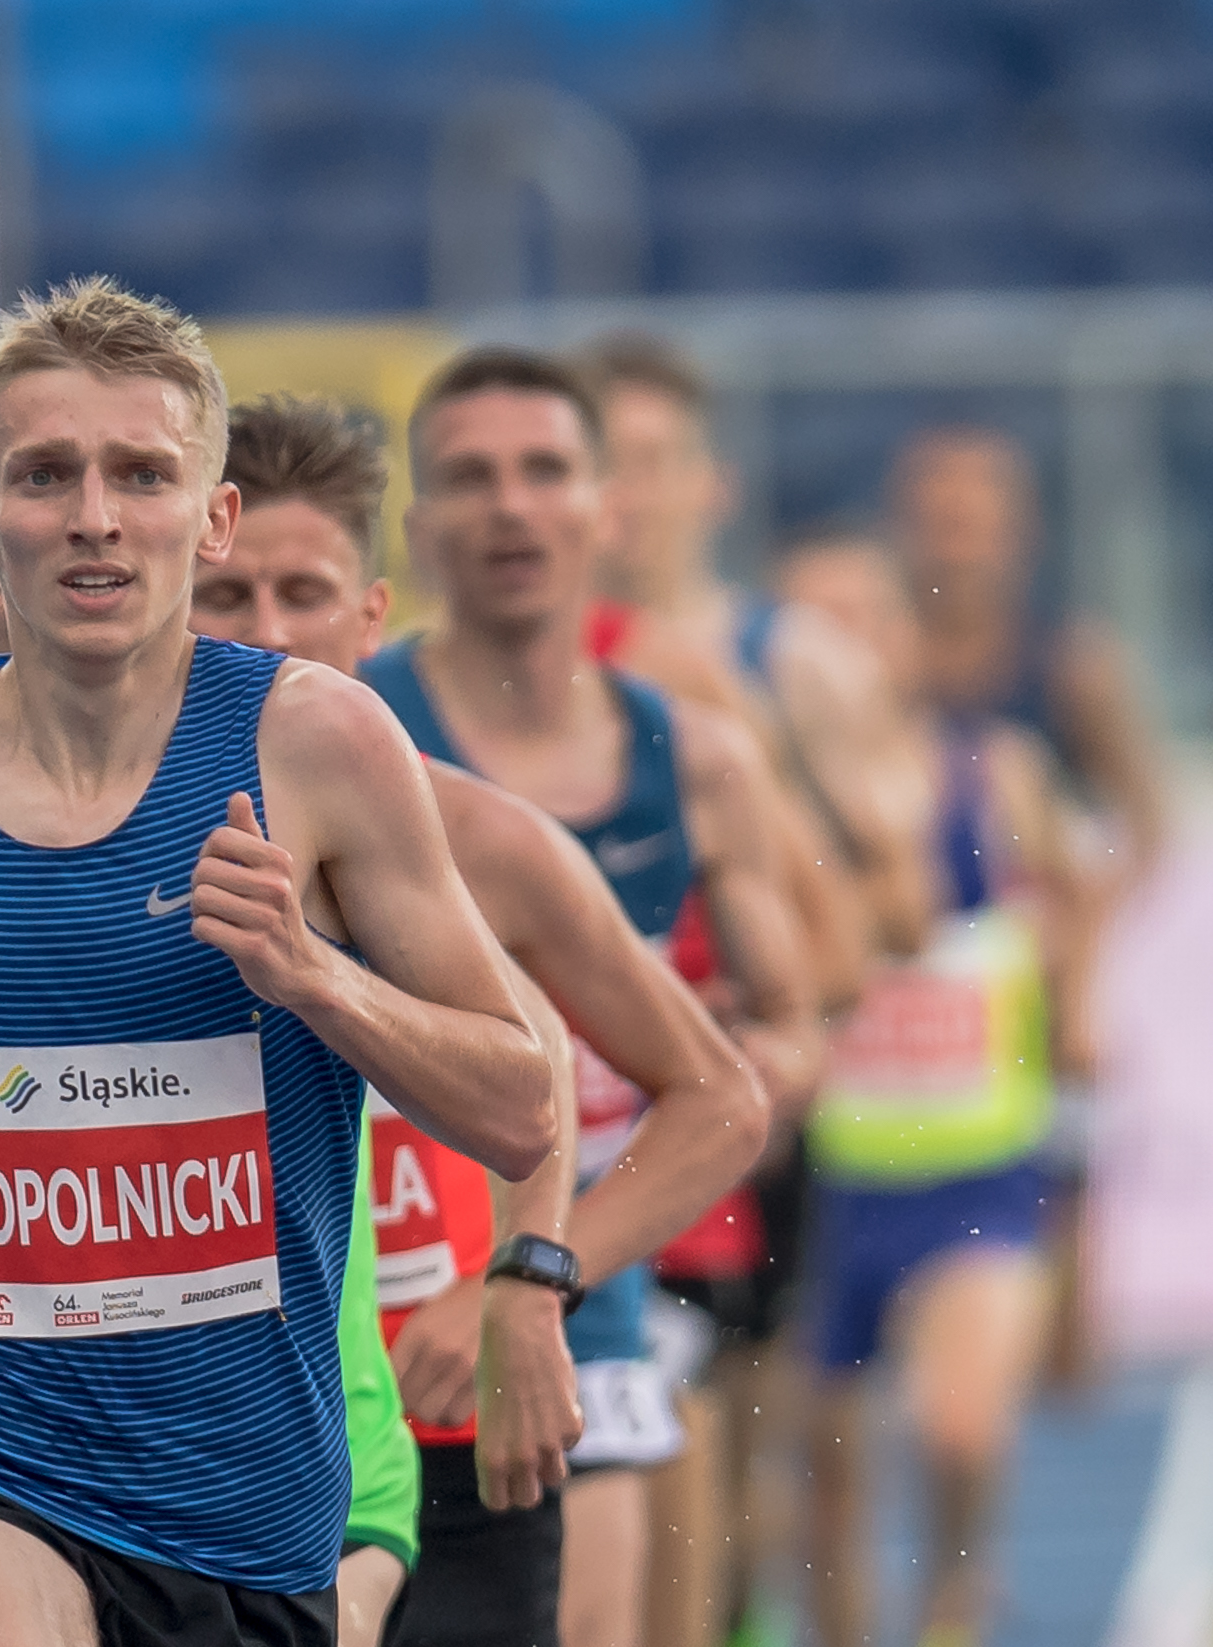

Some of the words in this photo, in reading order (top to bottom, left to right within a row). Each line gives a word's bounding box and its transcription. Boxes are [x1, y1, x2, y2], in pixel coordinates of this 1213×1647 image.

[59, 1065, 191, 1108] Śląskie.
[101, 1287, 143, 1300] Memorial
[181, 1279, 263, 1305] BRIDGESTONE
[53, 1294, 81, 1312] 64.
[57, 1312, 97, 1325] ORLEN
